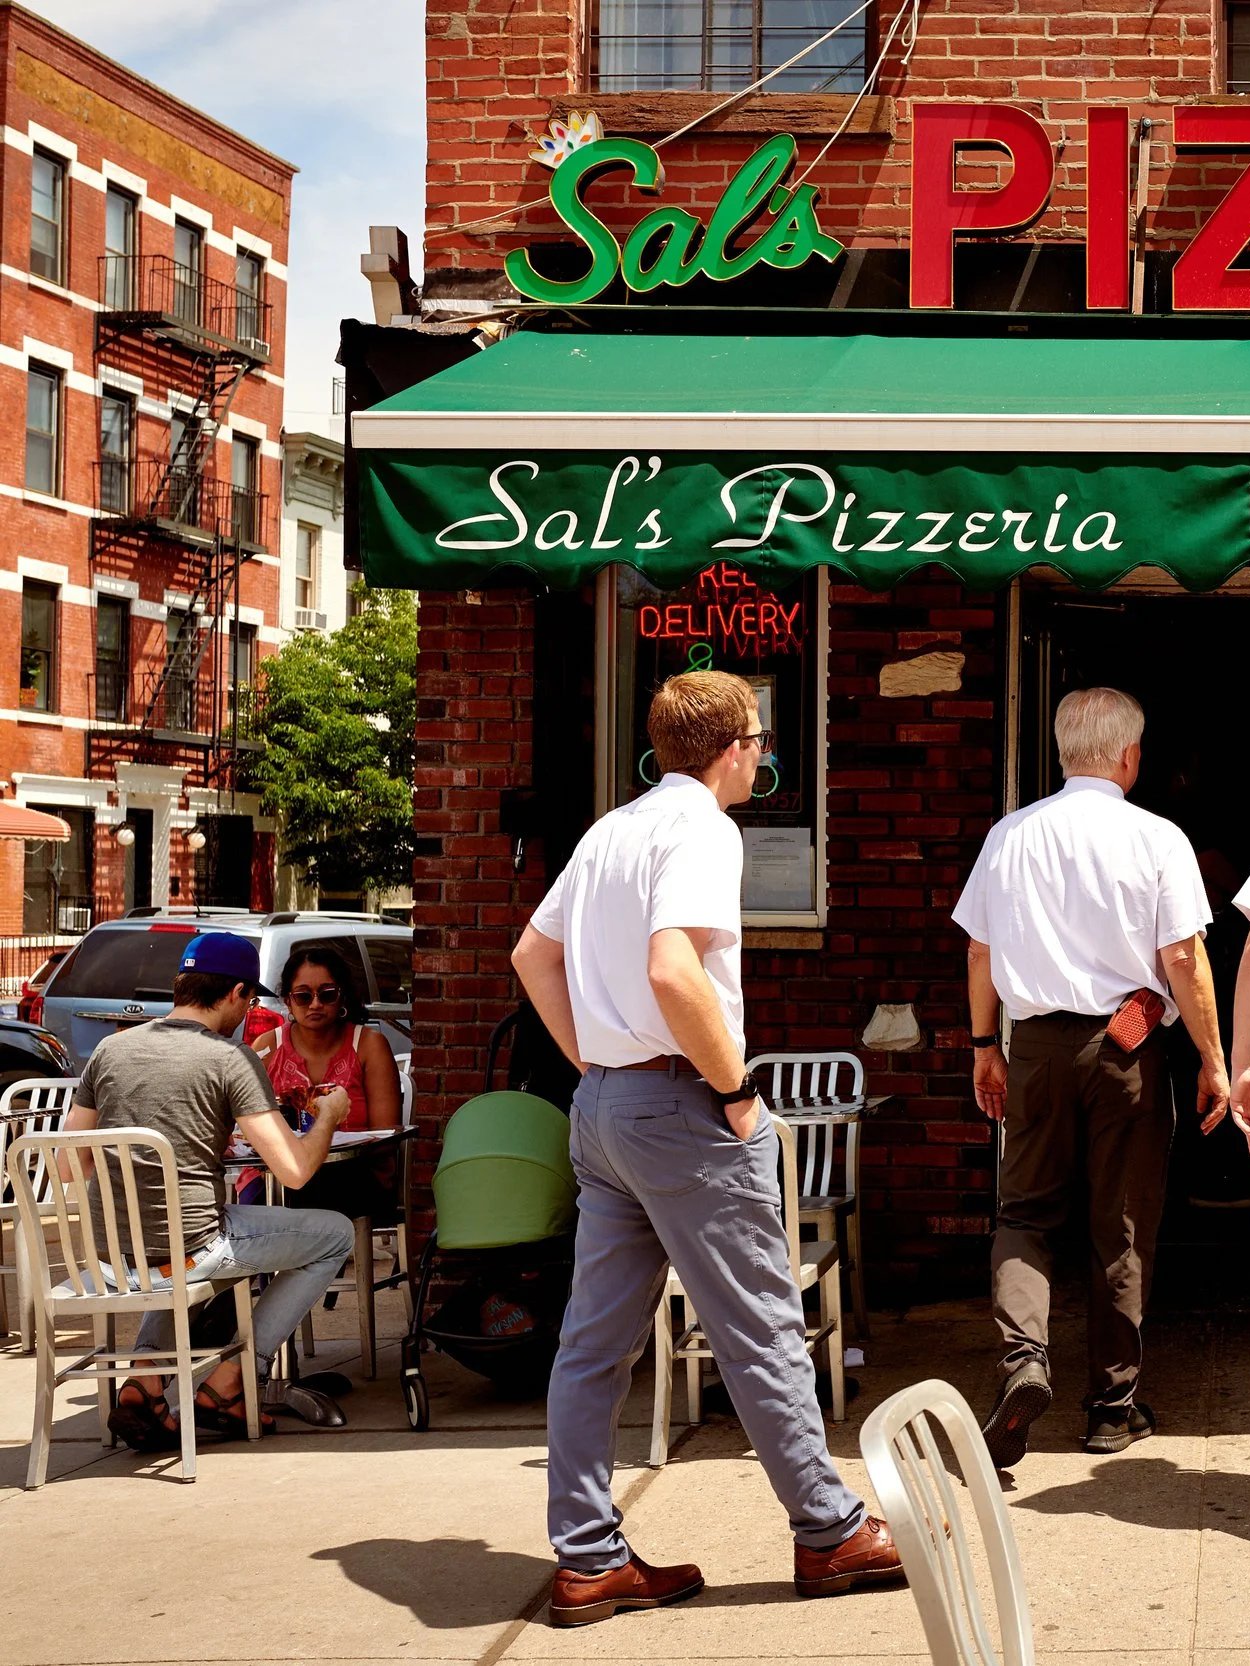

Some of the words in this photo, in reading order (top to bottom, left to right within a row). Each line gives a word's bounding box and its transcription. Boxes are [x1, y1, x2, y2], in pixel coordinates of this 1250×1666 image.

[504, 131, 846, 305] Sal's
[436, 456, 671, 550] Sal's
[712, 463, 1122, 552] Pizzeria
[640, 602, 800, 637] DELIVERY
[125, 1005, 142, 1013] KIA
